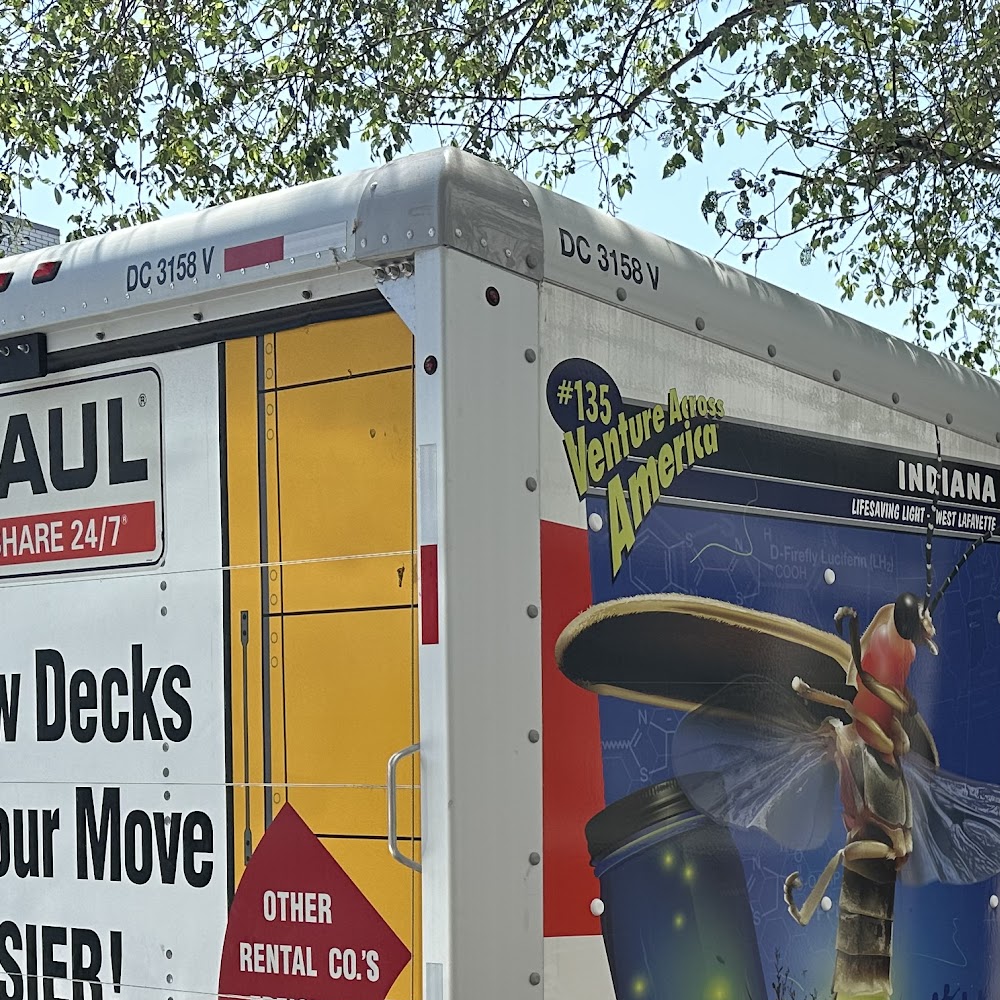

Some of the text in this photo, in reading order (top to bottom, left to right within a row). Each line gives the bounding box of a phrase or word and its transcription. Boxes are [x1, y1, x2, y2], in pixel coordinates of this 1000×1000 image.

[126, 246, 215, 292] DC 3158 V
[559, 228, 660, 290] DC 3158 V
[556, 379, 612, 426] #135
[563, 387, 726, 500] Venture Across
[607, 419, 719, 579] America
[898, 459, 996, 503] INDIANA
[851, 498, 997, 532] LIFESAVING LIGHT WEST LAFAYETTE
[0, 520, 64, 558] HARE
[35, 643, 193, 744] Decks
[75, 786, 215, 889] Move
[263, 890, 333, 925] OTHER
[239, 941, 380, 983] RENTAL CO.'S
